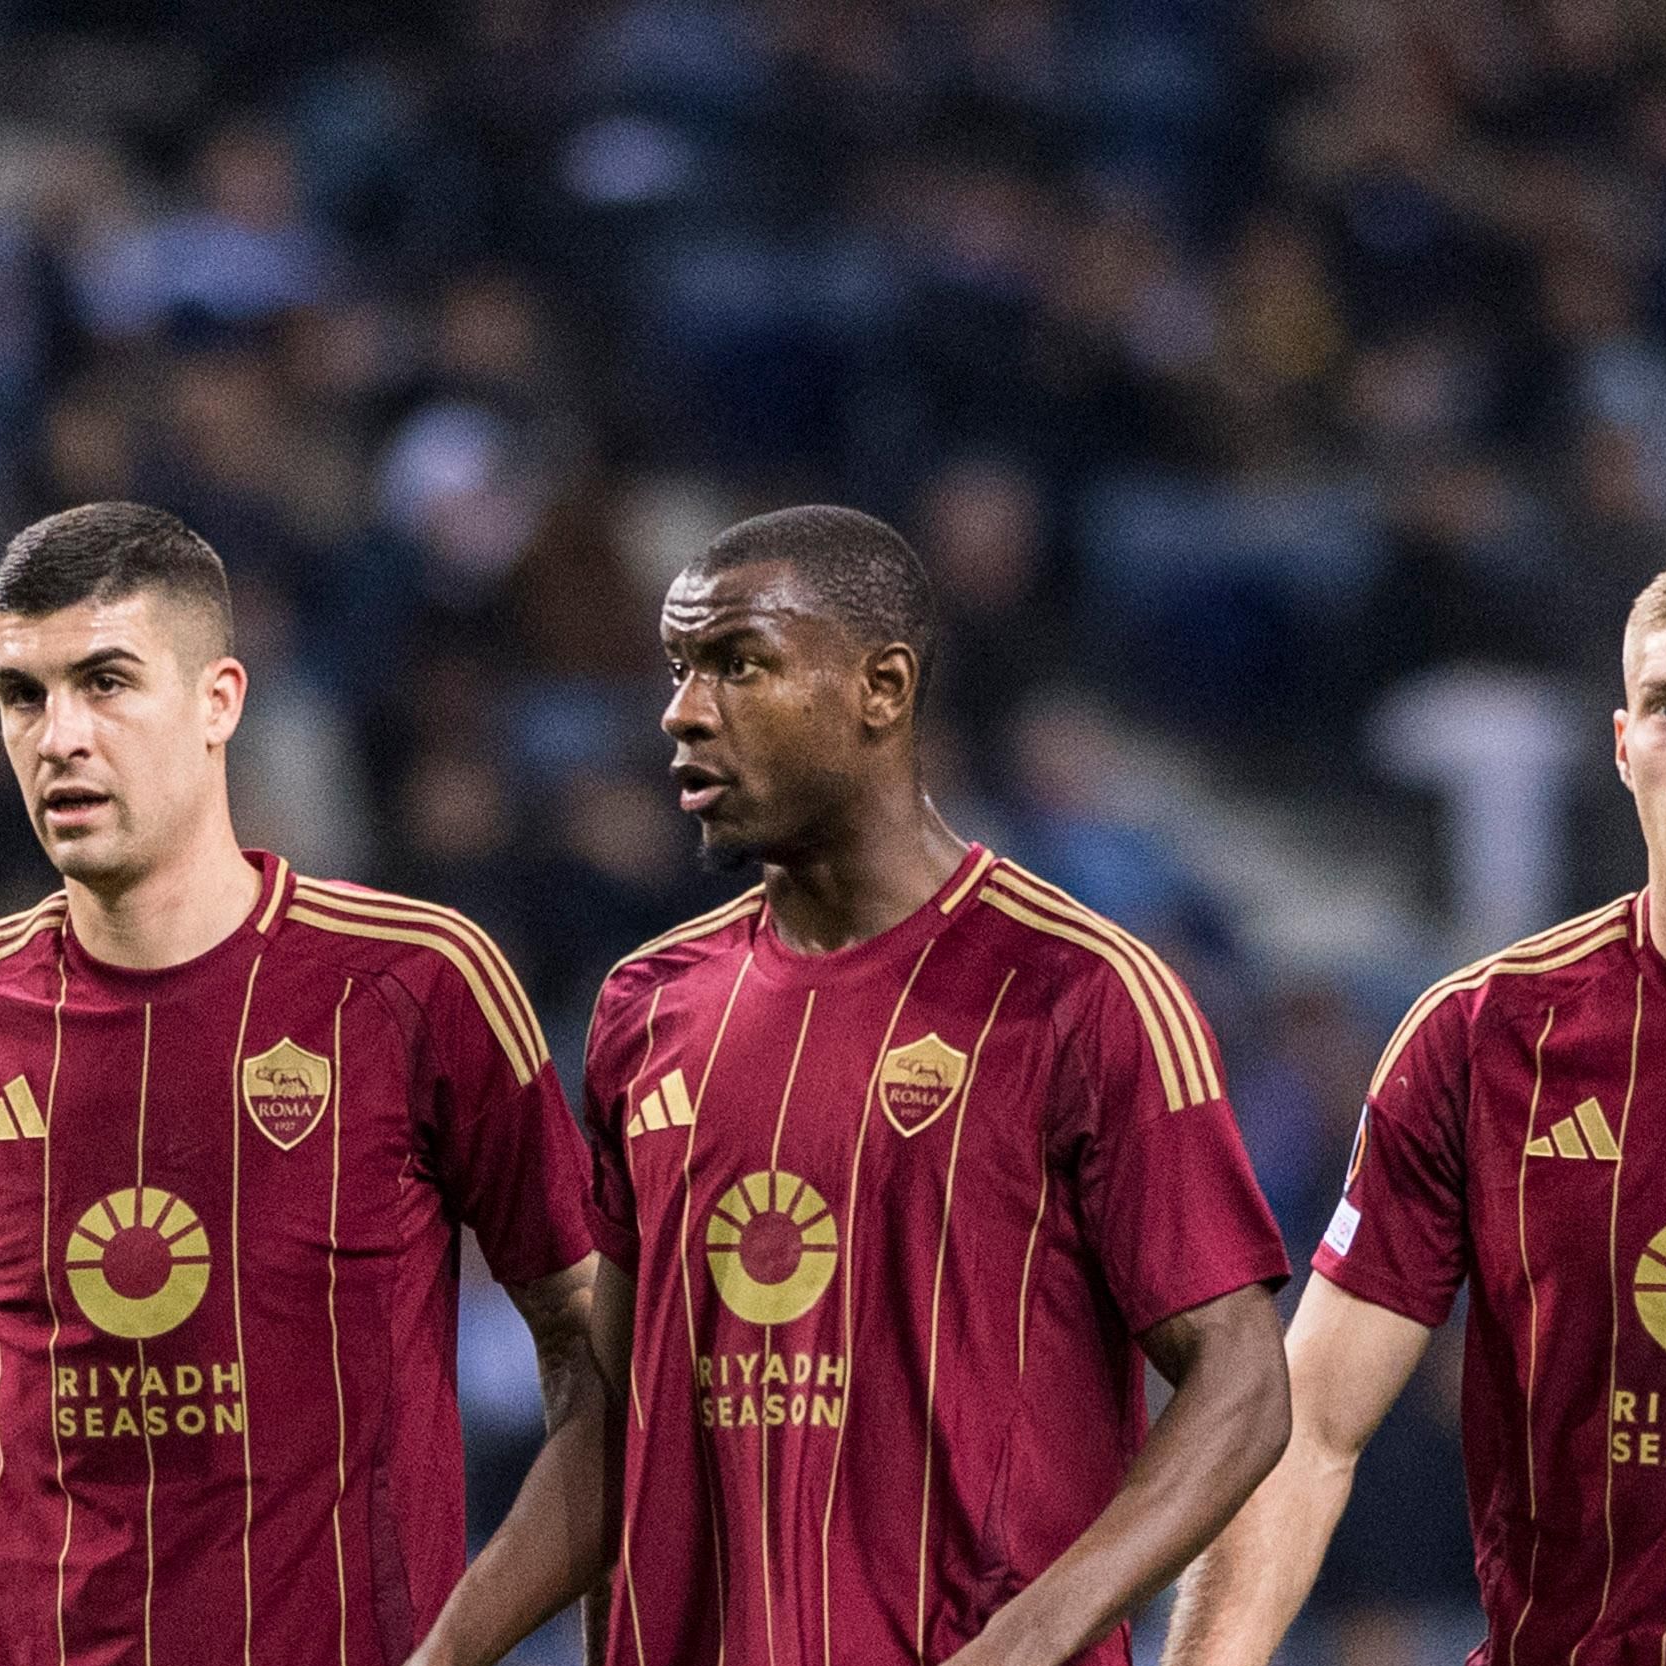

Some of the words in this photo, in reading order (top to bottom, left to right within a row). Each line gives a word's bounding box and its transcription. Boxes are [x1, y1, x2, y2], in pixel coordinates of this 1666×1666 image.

[258, 1101, 313, 1118] ROMA
[889, 1087, 940, 1106] ROMA
[57, 1362, 241, 1398] RIYADH
[698, 1353, 845, 1388] RIYADH
[57, 1403, 243, 1438] SEASON
[701, 1394, 842, 1428] SEASON
